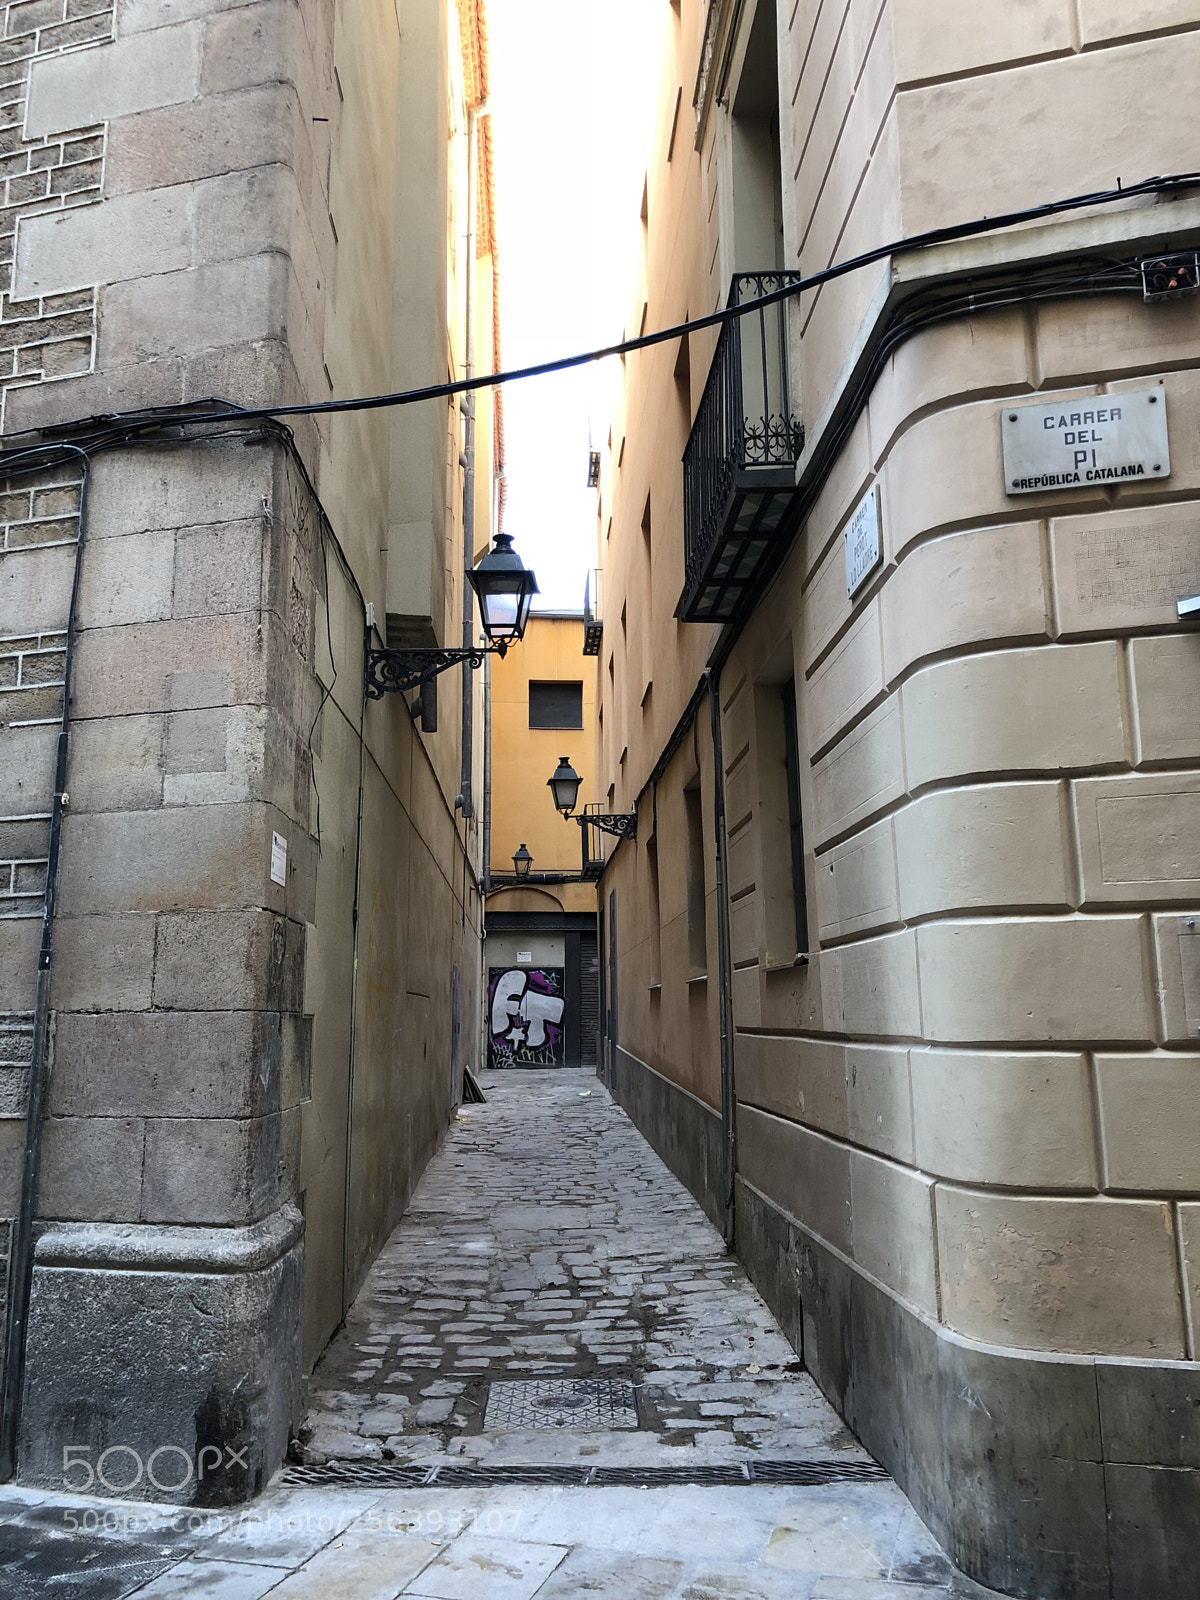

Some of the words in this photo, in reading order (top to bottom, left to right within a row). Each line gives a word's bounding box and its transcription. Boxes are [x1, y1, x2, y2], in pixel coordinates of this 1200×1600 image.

[1043, 407, 1122, 430] CARRER
[1064, 429, 1103, 446] DEL
[1073, 448, 1097, 470] PI
[1020, 472, 1080, 489] REPÚBLICA
[1086, 464, 1144, 481] CATALANA
[851, 502, 868, 534] CARRER
[857, 524, 863, 538] DE
